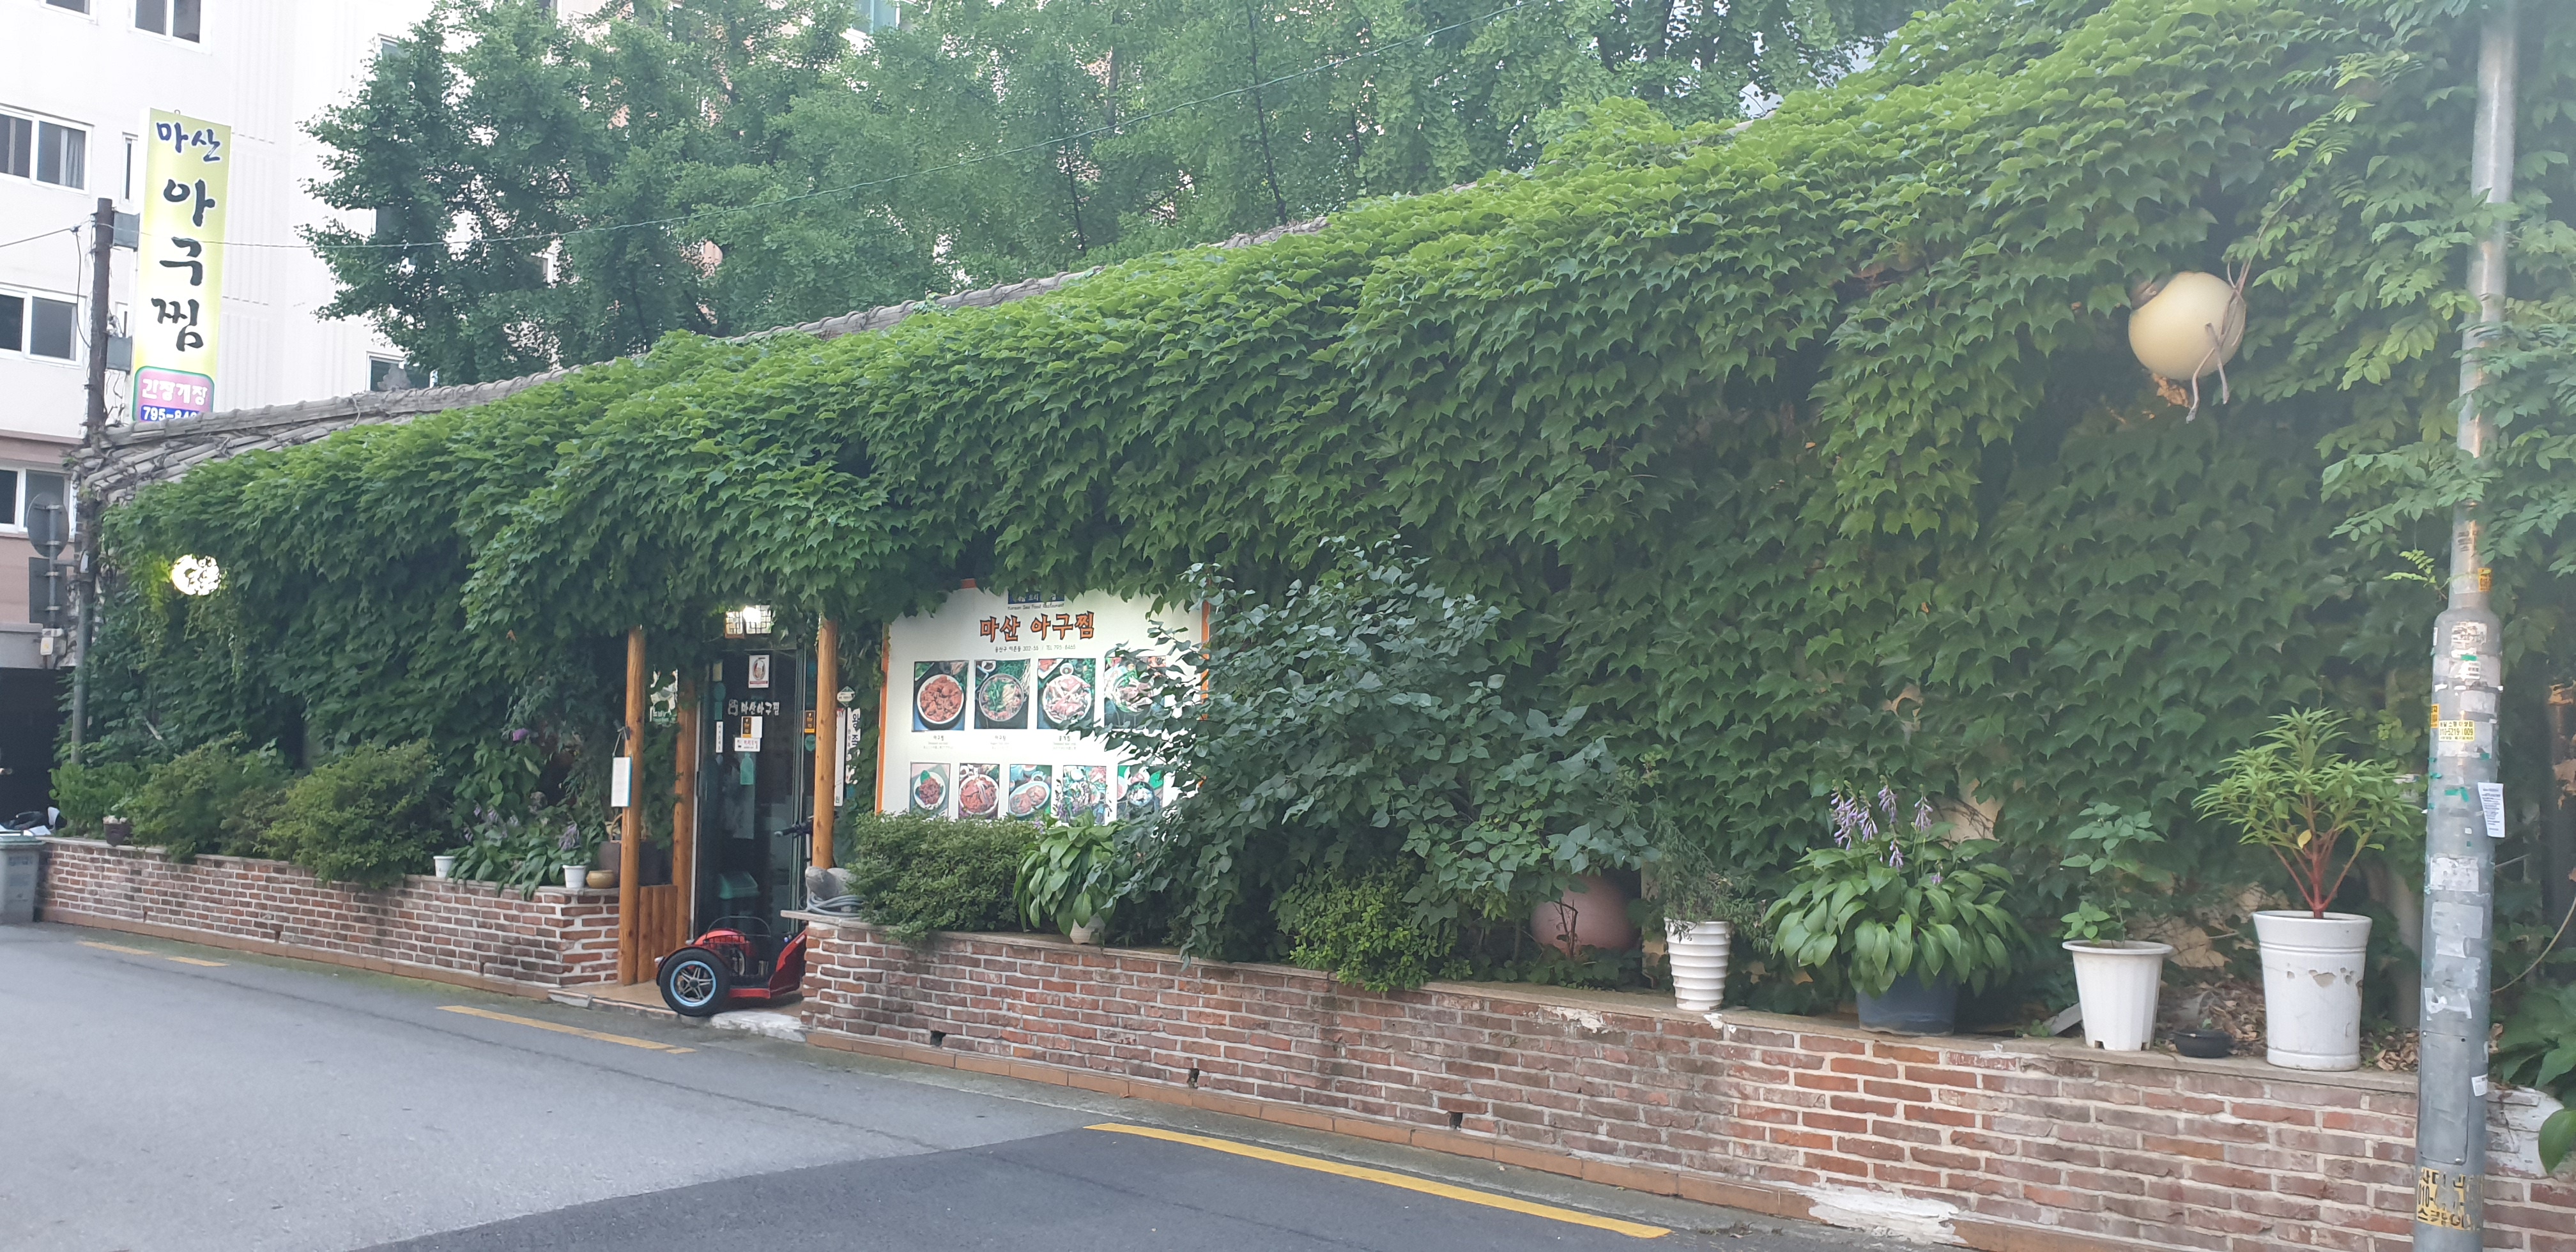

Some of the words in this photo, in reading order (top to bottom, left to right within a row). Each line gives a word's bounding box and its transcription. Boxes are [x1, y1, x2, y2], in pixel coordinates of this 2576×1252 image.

[156, 122, 220, 162] 마산
[151, 179, 216, 352] 아구찜
[142, 378, 208, 406] 간장게장
[143, 406, 197, 422] 795-84
[980, 615, 1021, 643] 마산
[1030, 610, 1094, 641] 아구찜
